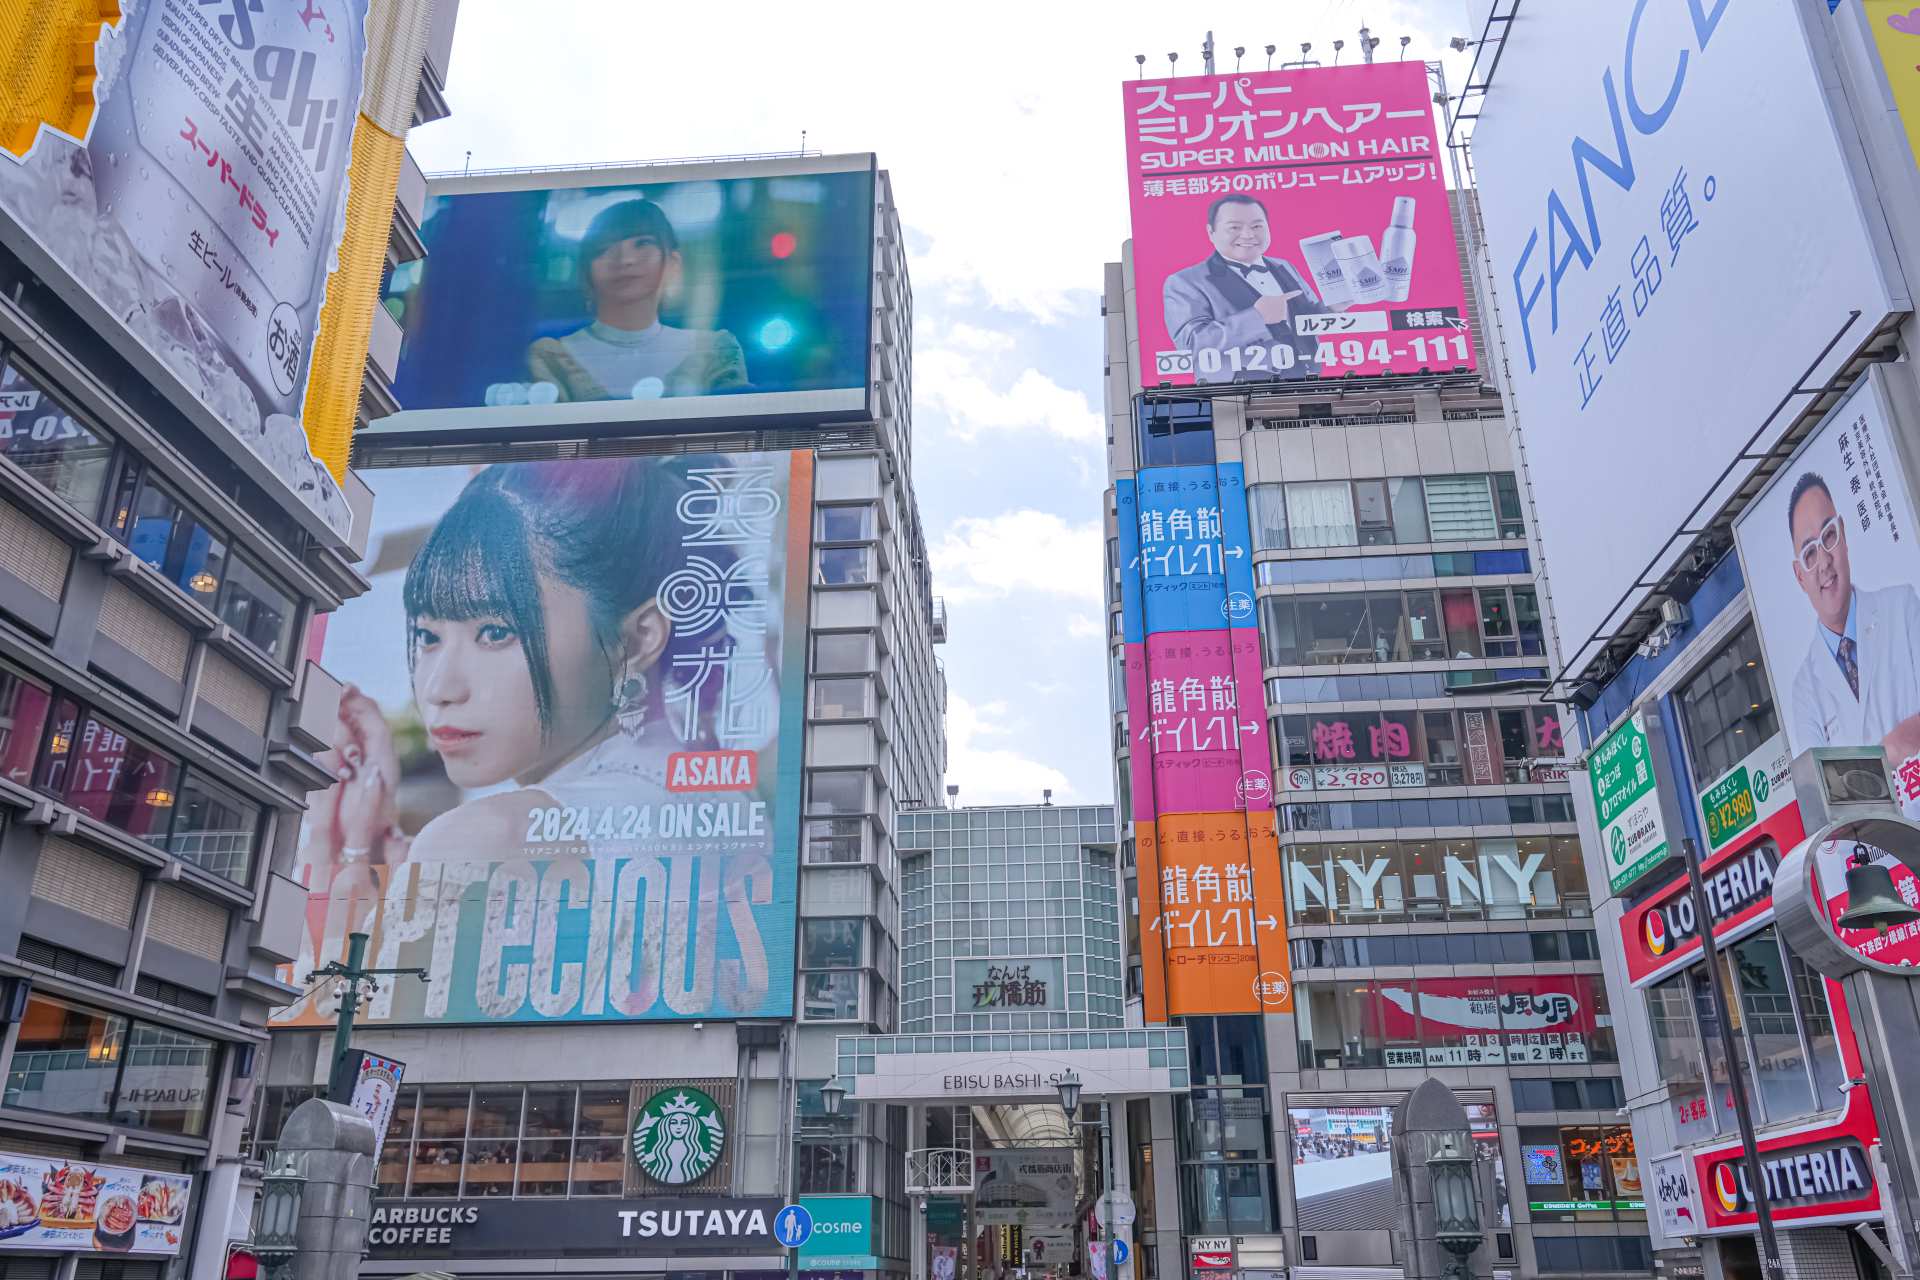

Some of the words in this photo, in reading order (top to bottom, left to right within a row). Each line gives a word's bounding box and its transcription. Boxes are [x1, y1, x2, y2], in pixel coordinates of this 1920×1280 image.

[167, 39, 202, 79] ADVANCED
[186, 2, 210, 30] SUPER
[207, 26, 225, 47] DRY
[229, 56, 260, 95] BREWED
[189, 43, 226, 86] JAPANESE
[1136, 77, 1292, 114] スーパー
[1138, 102, 1425, 145] ミリオンヘアー
[1140, 149, 1234, 170] SUPER
[1244, 142, 1350, 163] MILLION
[1358, 136, 1430, 157] HAIR
[180, 115, 280, 249] スーパードライ
[277, 175, 314, 236] TECHNIQUES
[1573, 165, 1717, 411] 正直品質。
[1301, 316, 1357, 333] ルアン
[1405, 311, 1447, 328] 検索
[269, 318, 301, 385] お酒
[1197, 334, 1469, 374] 0120-494-111
[1140, 506, 1225, 545] 龍角散
[1128, 543, 1244, 579] ダイレクト
[1151, 676, 1240, 714] 龍角散
[1139, 716, 1260, 753] ダイレクト
[1313, 720, 1411, 760] 焼肉
[1601, 732, 1628, 765] もみほぐし
[671, 755, 752, 787] ASAKA
[1608, 778, 1637, 813] アロマオイル
[1709, 777, 1737, 803] もみほぐし
[526, 804, 651, 843] 2024.4.24
[659, 803, 694, 838] ON
[696, 800, 767, 837] SALE
[1718, 789, 1752, 830] ¥2,980
[1627, 819, 1656, 847] ZUBORAYA
[1162, 863, 1256, 905] 龍角散
[1290, 855, 1390, 912] NY
[1444, 853, 1545, 906] NY
[1665, 848, 1774, 938] LOTERIA
[1150, 908, 1278, 949] ダイレクト
[987, 965, 1030, 980] なんば
[1469, 1001, 1497, 1015] 鶴橋
[1500, 989, 1572, 1023] 風月
[1386, 1050, 1422, 1065] 営業時間
[943, 1075, 989, 1089] EBISU
[371, 1207, 479, 1224] ARBUCKS
[618, 1210, 768, 1238] TSUTAYA
[813, 1222, 862, 1234] cosme
[368, 1227, 452, 1244] COFFEE
